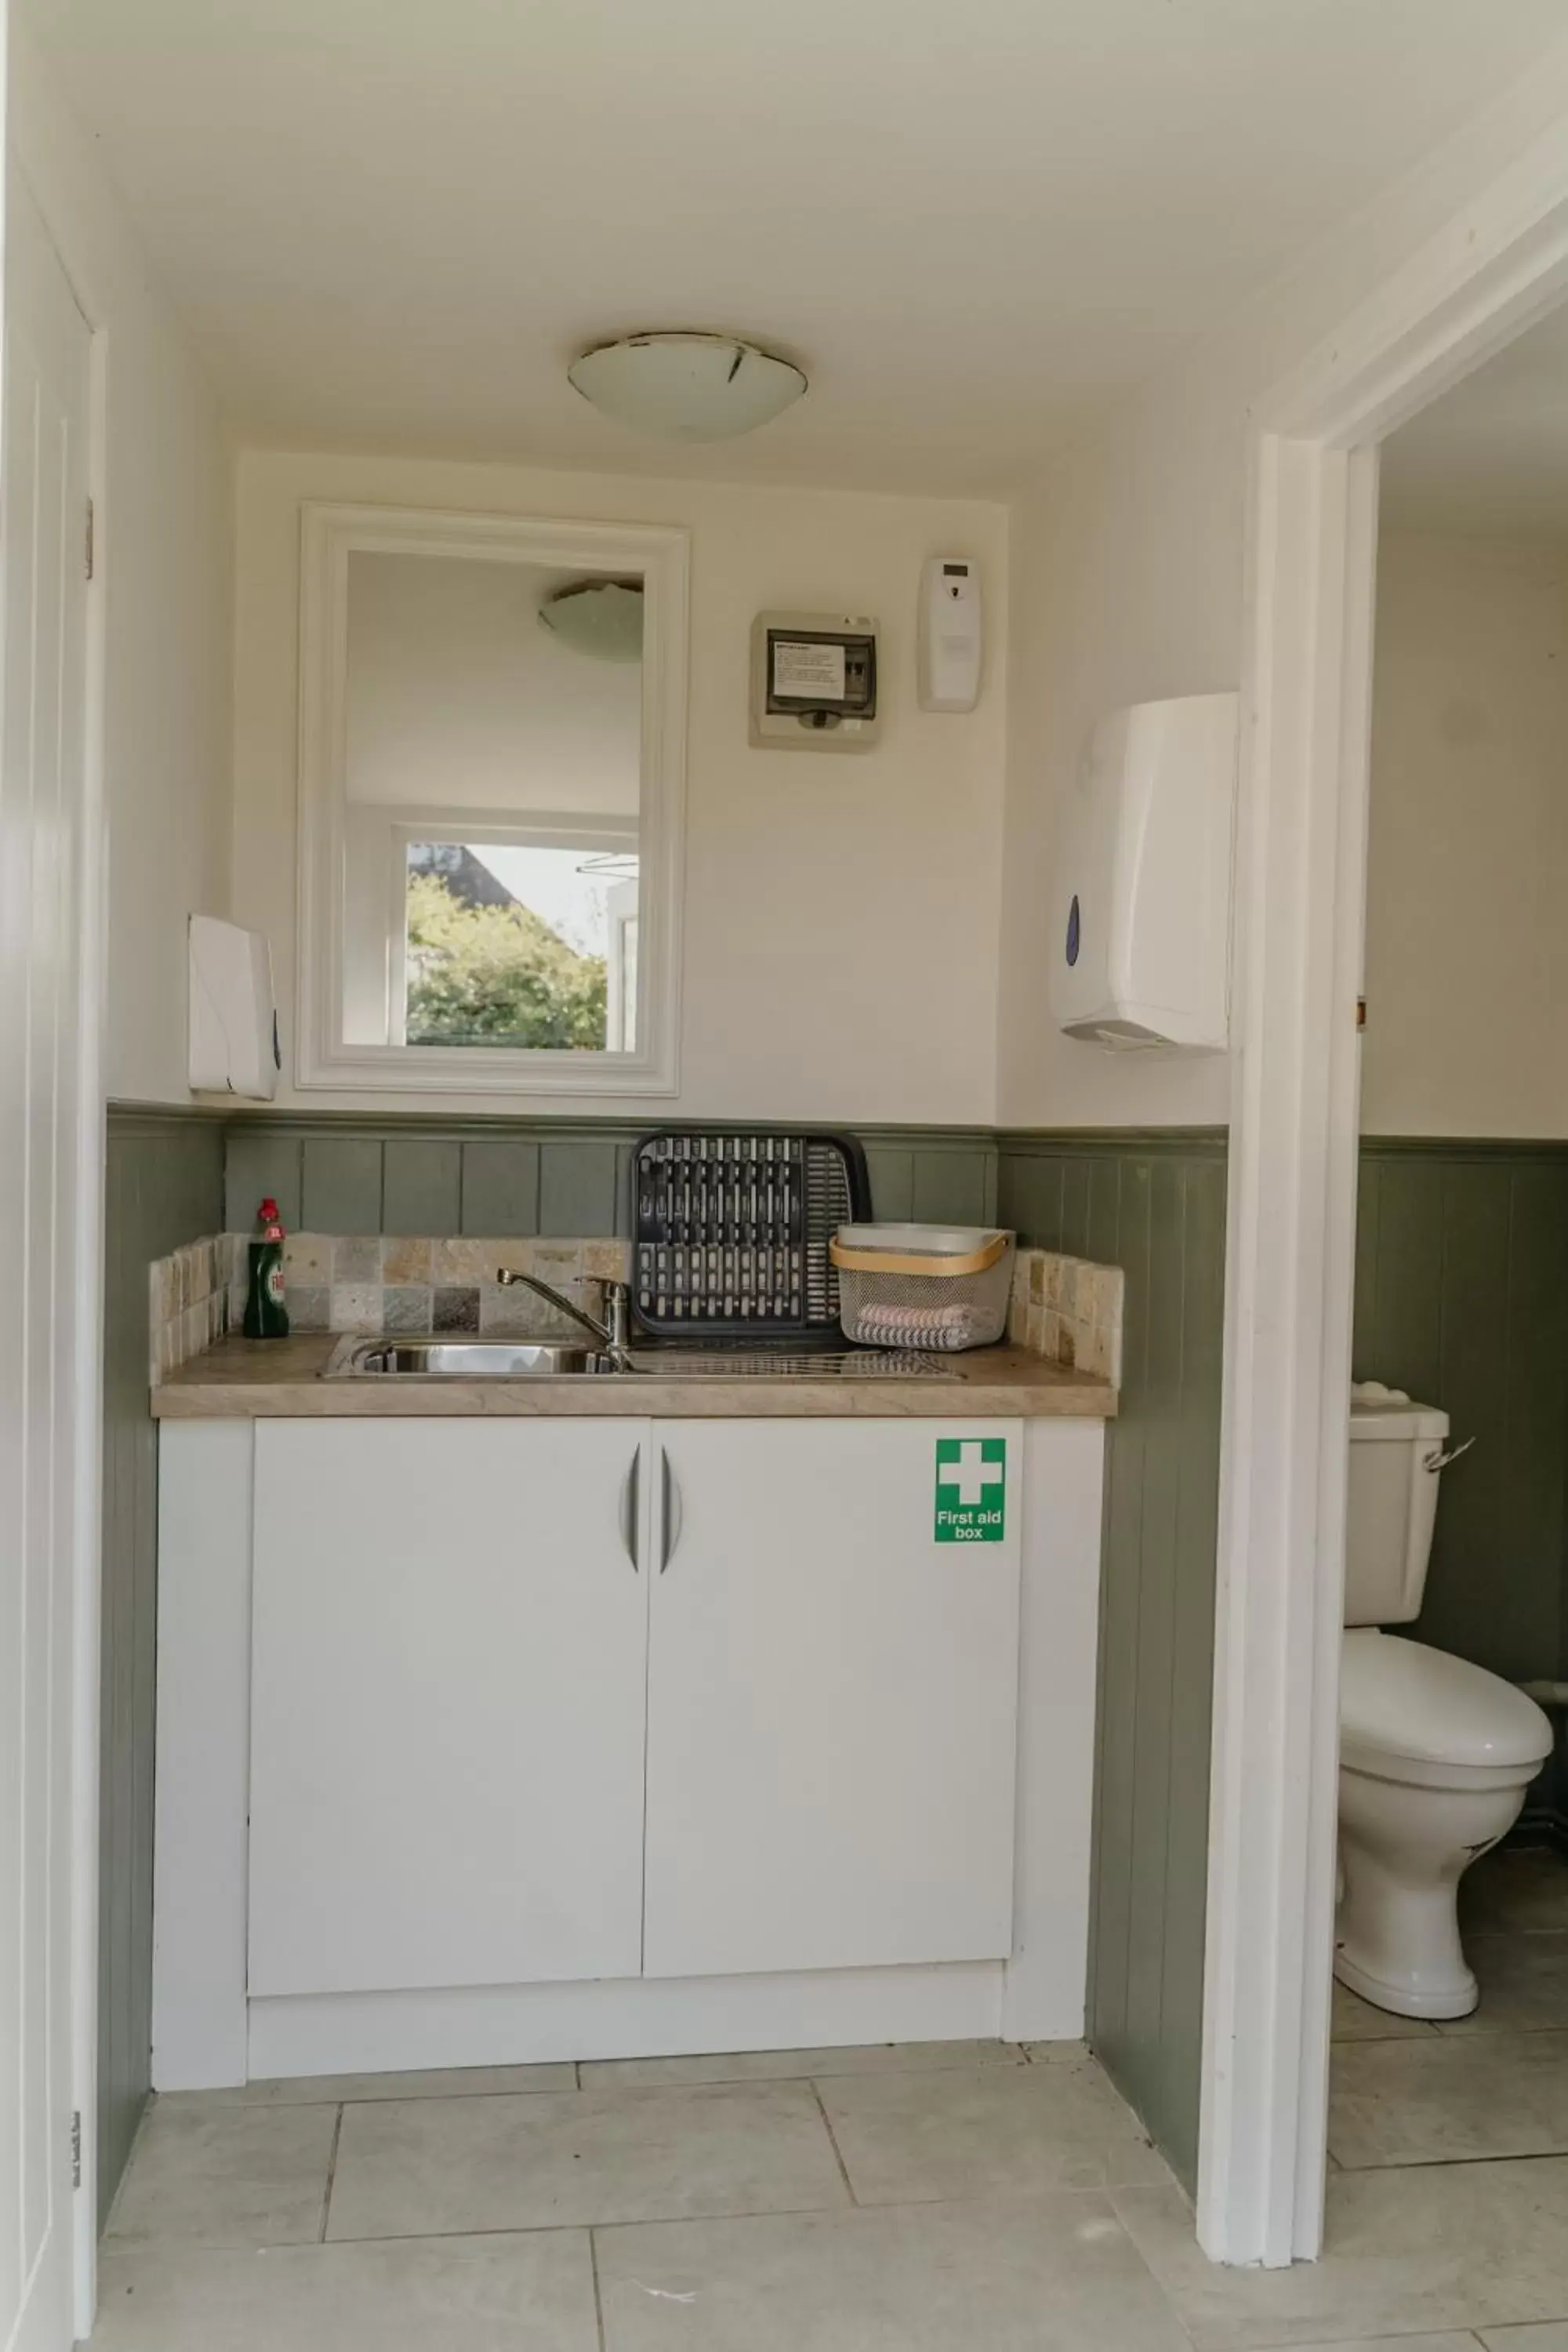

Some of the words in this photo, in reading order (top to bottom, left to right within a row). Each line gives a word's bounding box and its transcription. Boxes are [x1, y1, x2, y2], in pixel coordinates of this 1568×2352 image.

[938, 1511, 973, 1525] First
[978, 1510, 1001, 1524] aid
[955, 1526, 983, 1539] box
